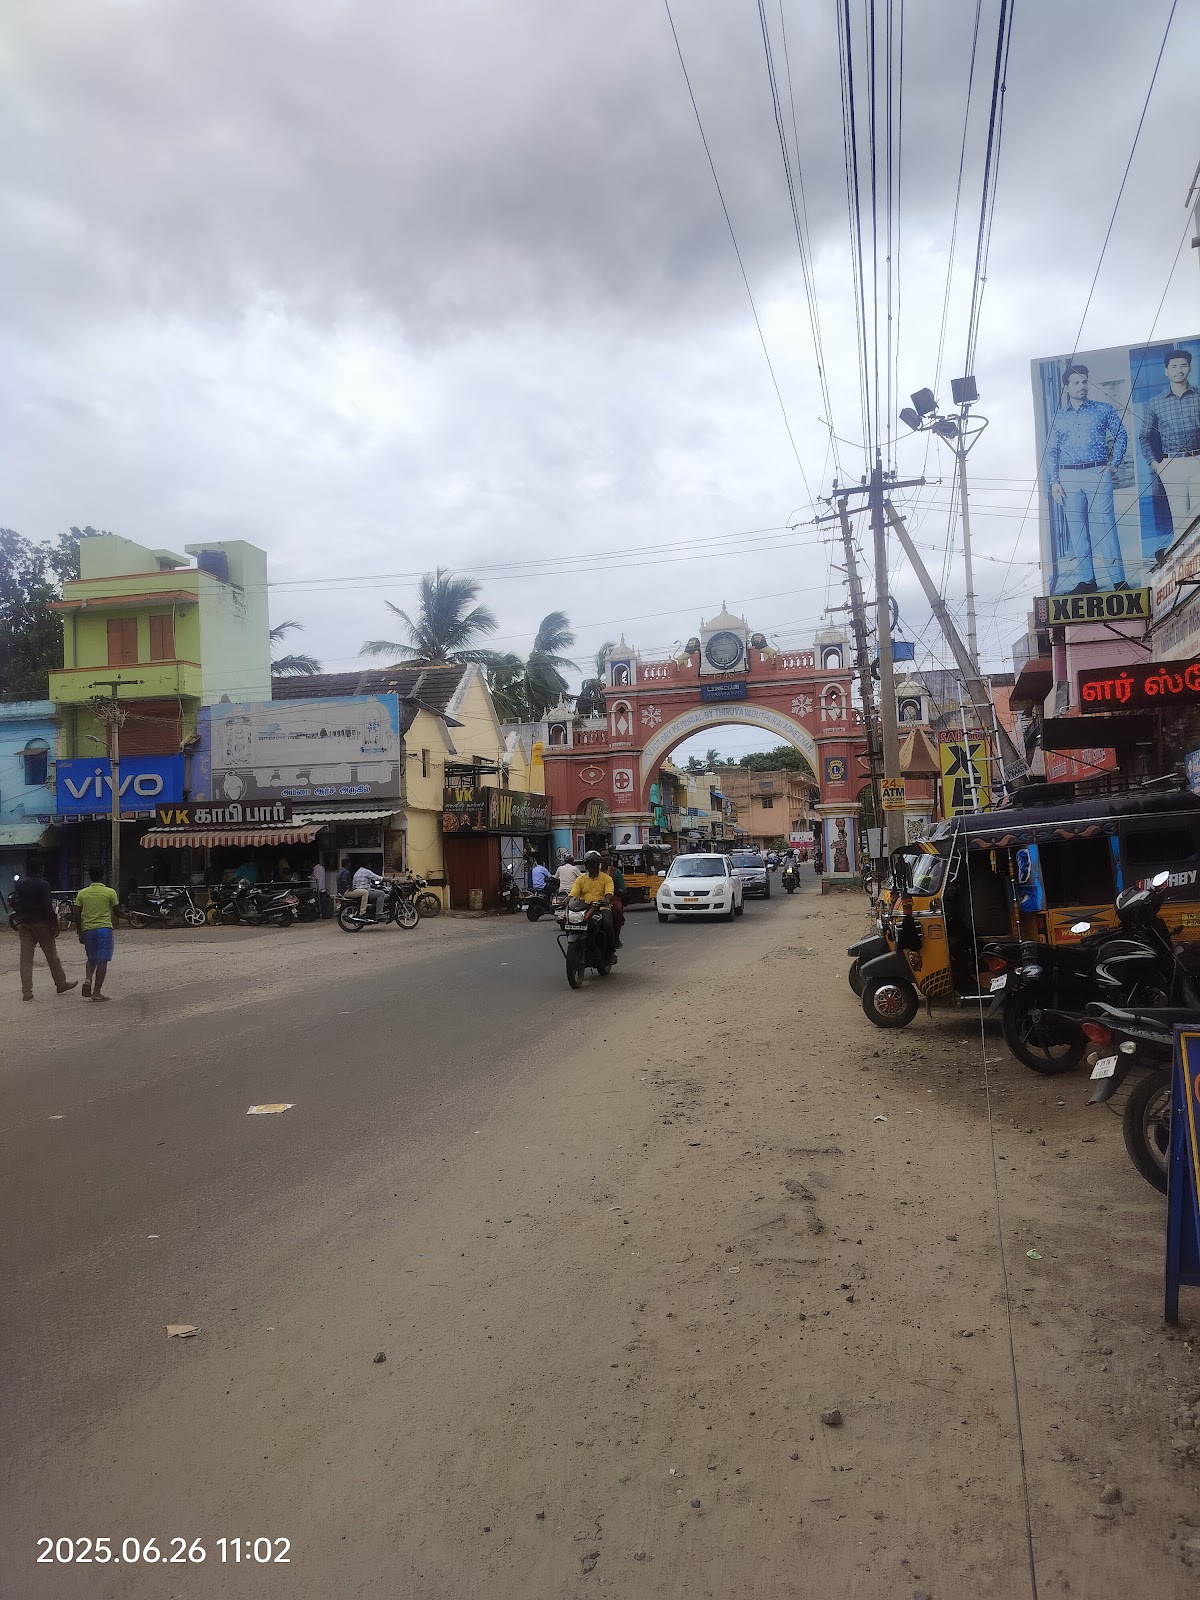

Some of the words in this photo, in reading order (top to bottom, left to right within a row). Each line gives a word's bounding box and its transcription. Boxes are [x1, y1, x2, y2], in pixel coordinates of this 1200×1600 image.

[1052, 592, 1145, 621] XEROX
[1082, 672, 1134, 704] ளர்
[645, 729, 674, 757] VICTORY
[673, 713, 703, 734] MEMORIAL
[704, 708, 714, 720] BY
[64, 768, 164, 799] vivo
[339, 784, 372, 796] அருகில்
[455, 788, 473, 802] VK
[882, 788, 905, 797] ATM
[160, 809, 190, 825] VK
[194, 803, 242, 824] காபி
[246, 802, 285, 822] பார்
